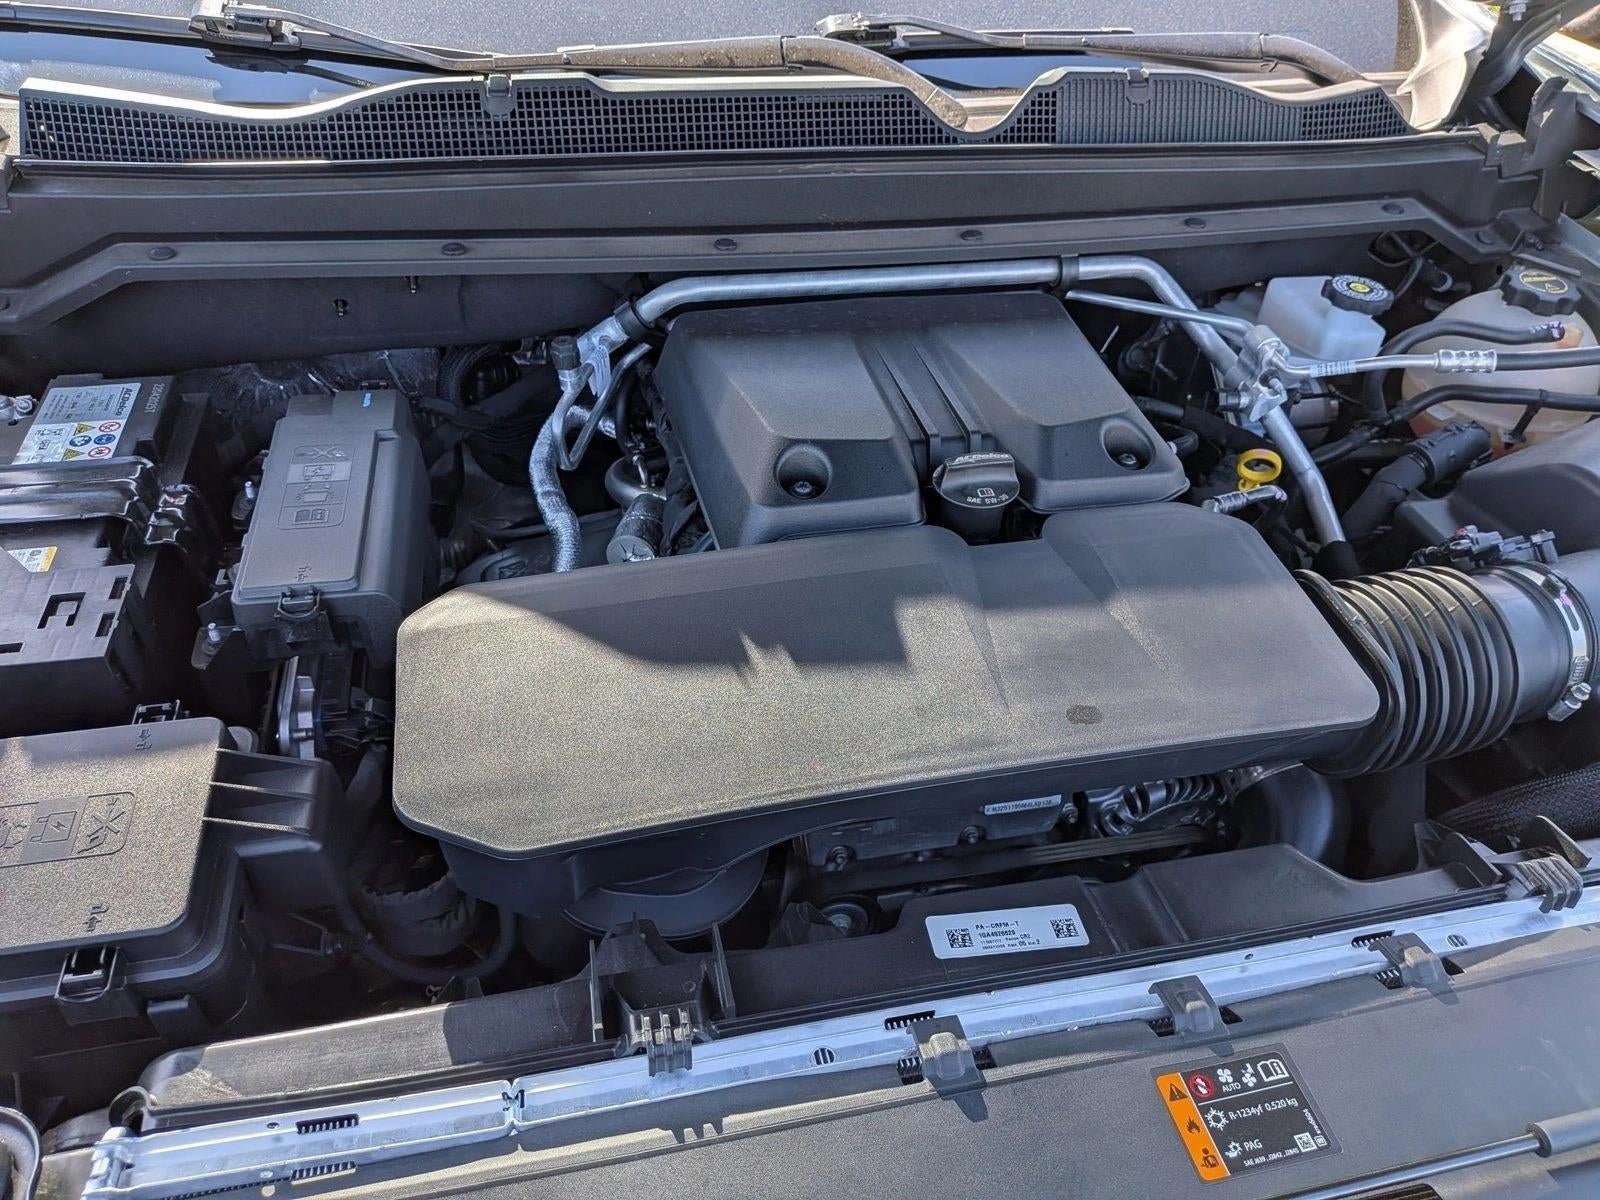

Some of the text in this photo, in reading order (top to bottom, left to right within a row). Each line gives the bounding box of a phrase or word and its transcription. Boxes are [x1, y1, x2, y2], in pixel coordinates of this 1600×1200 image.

[116, 388, 133, 416] ACDelco
[966, 496, 981, 504] SAE
[1222, 1082, 1241, 1092] AUTO
[1228, 1097, 1298, 1121] R-1234yf 0.520 kg
[1243, 1138, 1262, 1152] PAG
[1243, 1158, 1254, 1167] SAE
